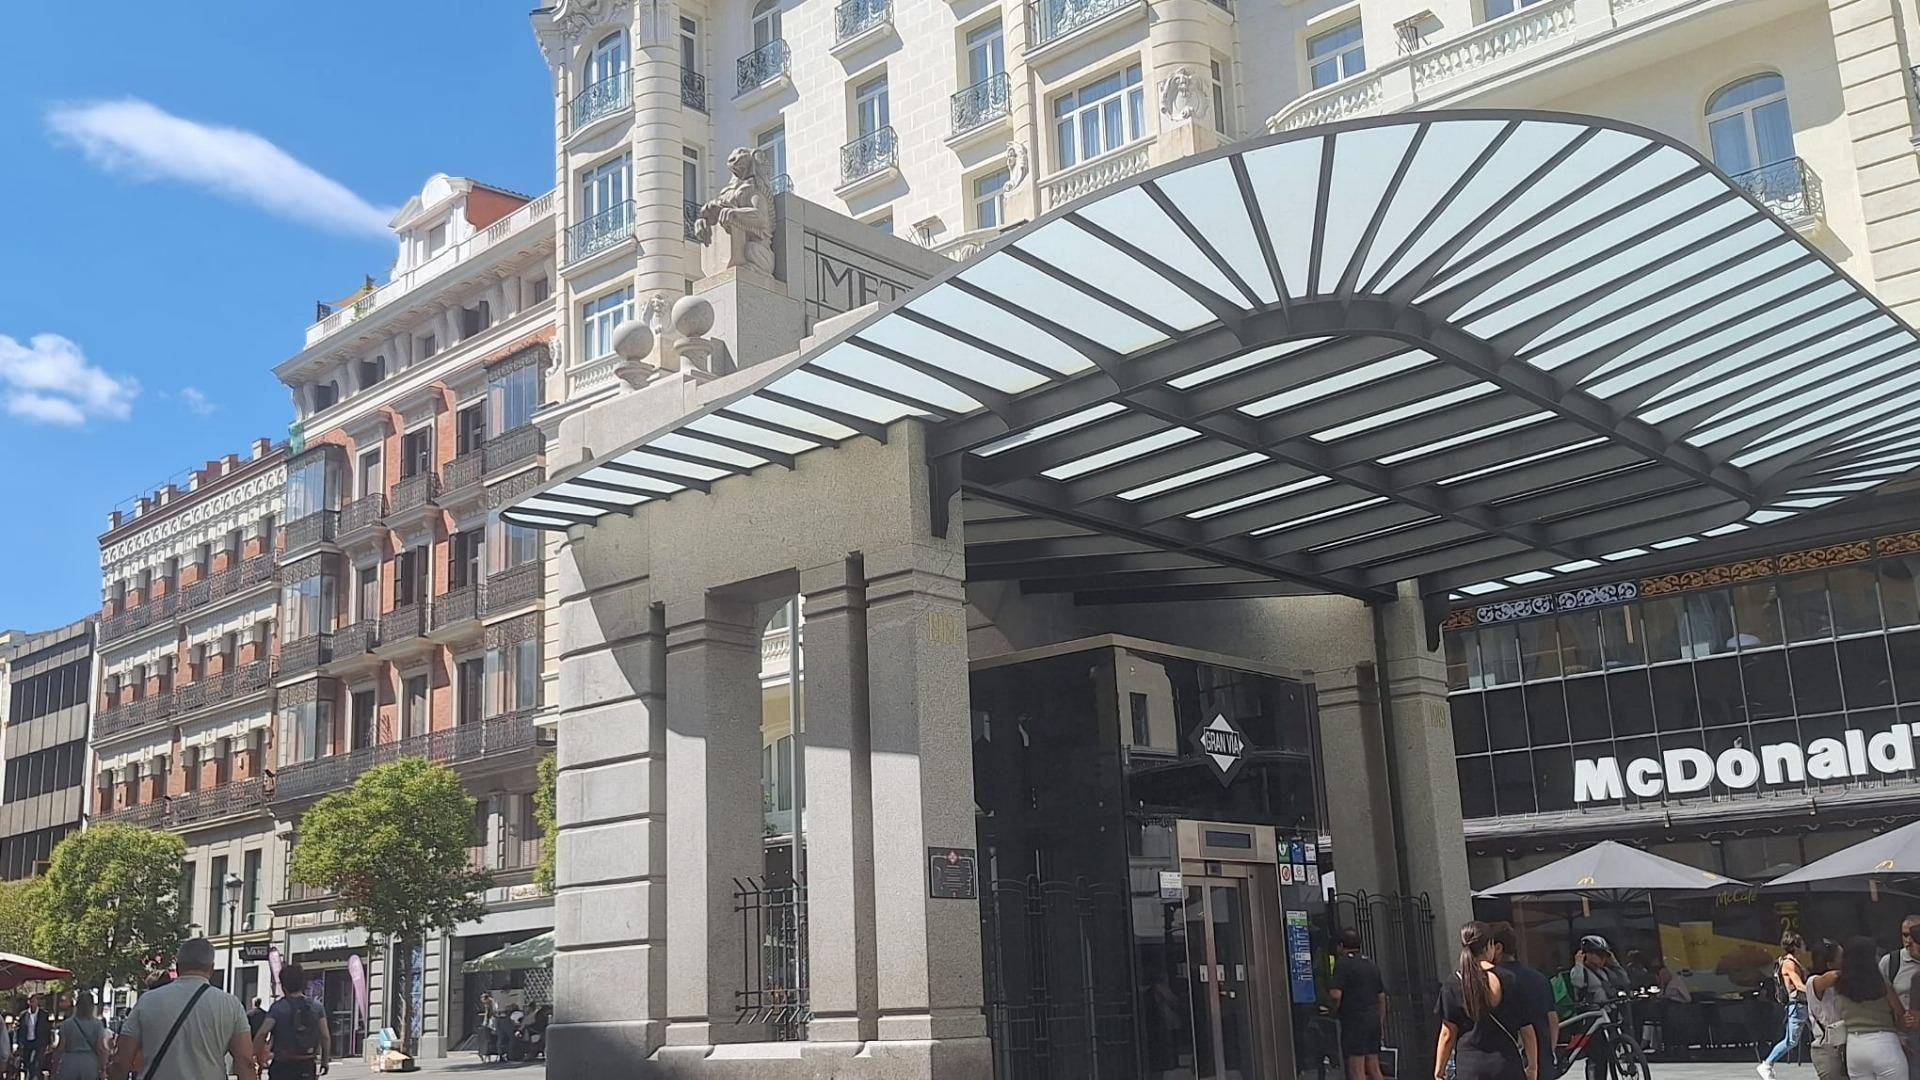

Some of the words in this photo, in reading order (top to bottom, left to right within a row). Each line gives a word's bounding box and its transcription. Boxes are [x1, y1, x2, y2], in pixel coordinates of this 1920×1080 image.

[820, 257, 909, 311] MET
[1206, 731, 1226, 752] GRAN
[246, 946, 268, 956] VANS
[308, 936, 328, 950] TACO
[328, 934, 347, 949] BELL
